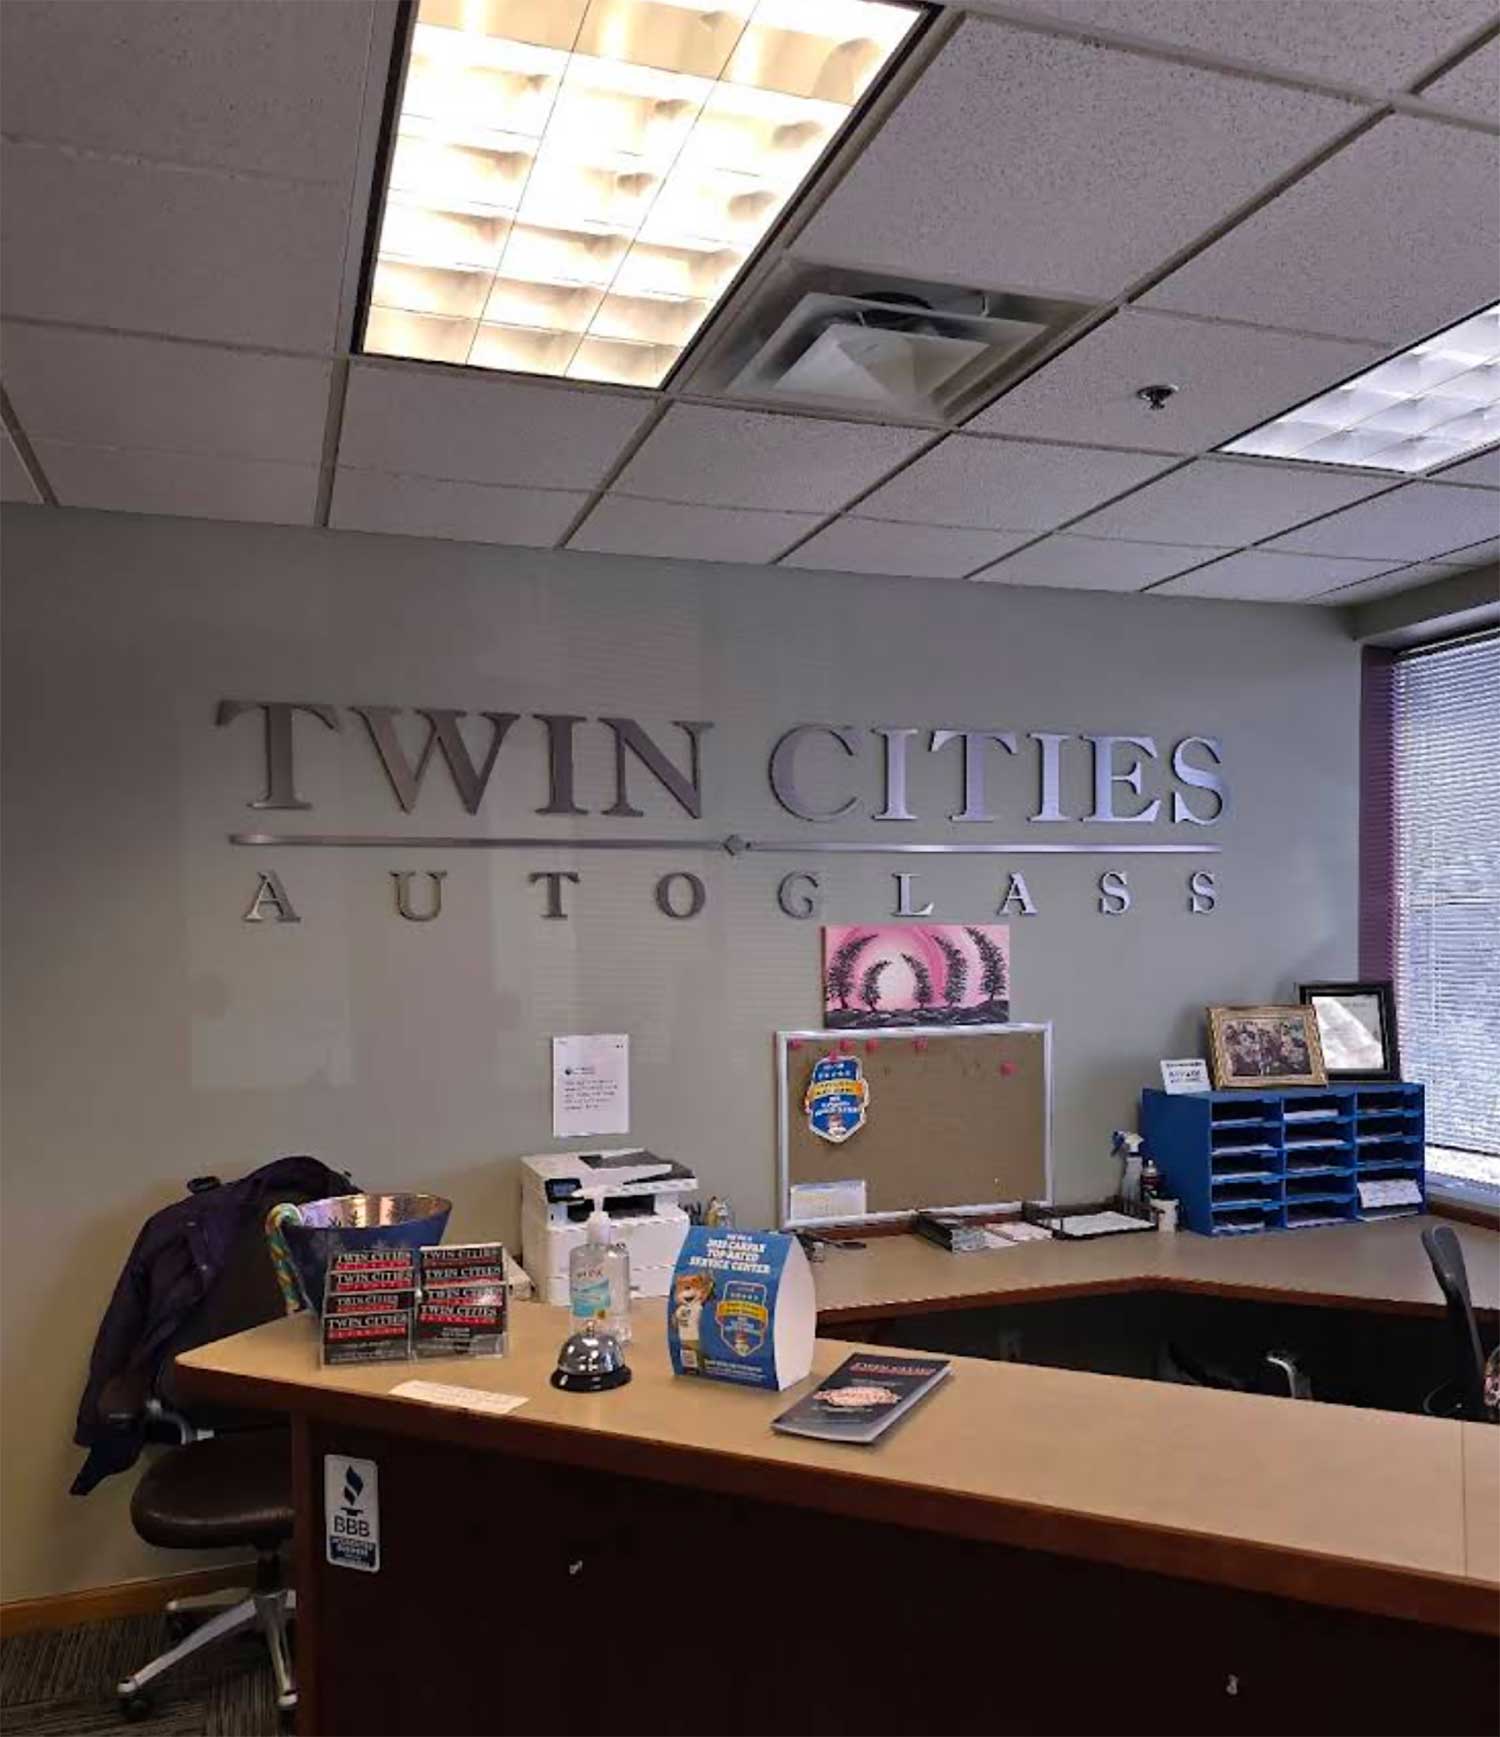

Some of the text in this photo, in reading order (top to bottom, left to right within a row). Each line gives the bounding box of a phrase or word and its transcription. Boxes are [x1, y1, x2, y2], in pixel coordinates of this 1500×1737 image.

[215, 699, 1230, 826] TWIN CITIES
[334, 1515, 370, 1537] BBB
